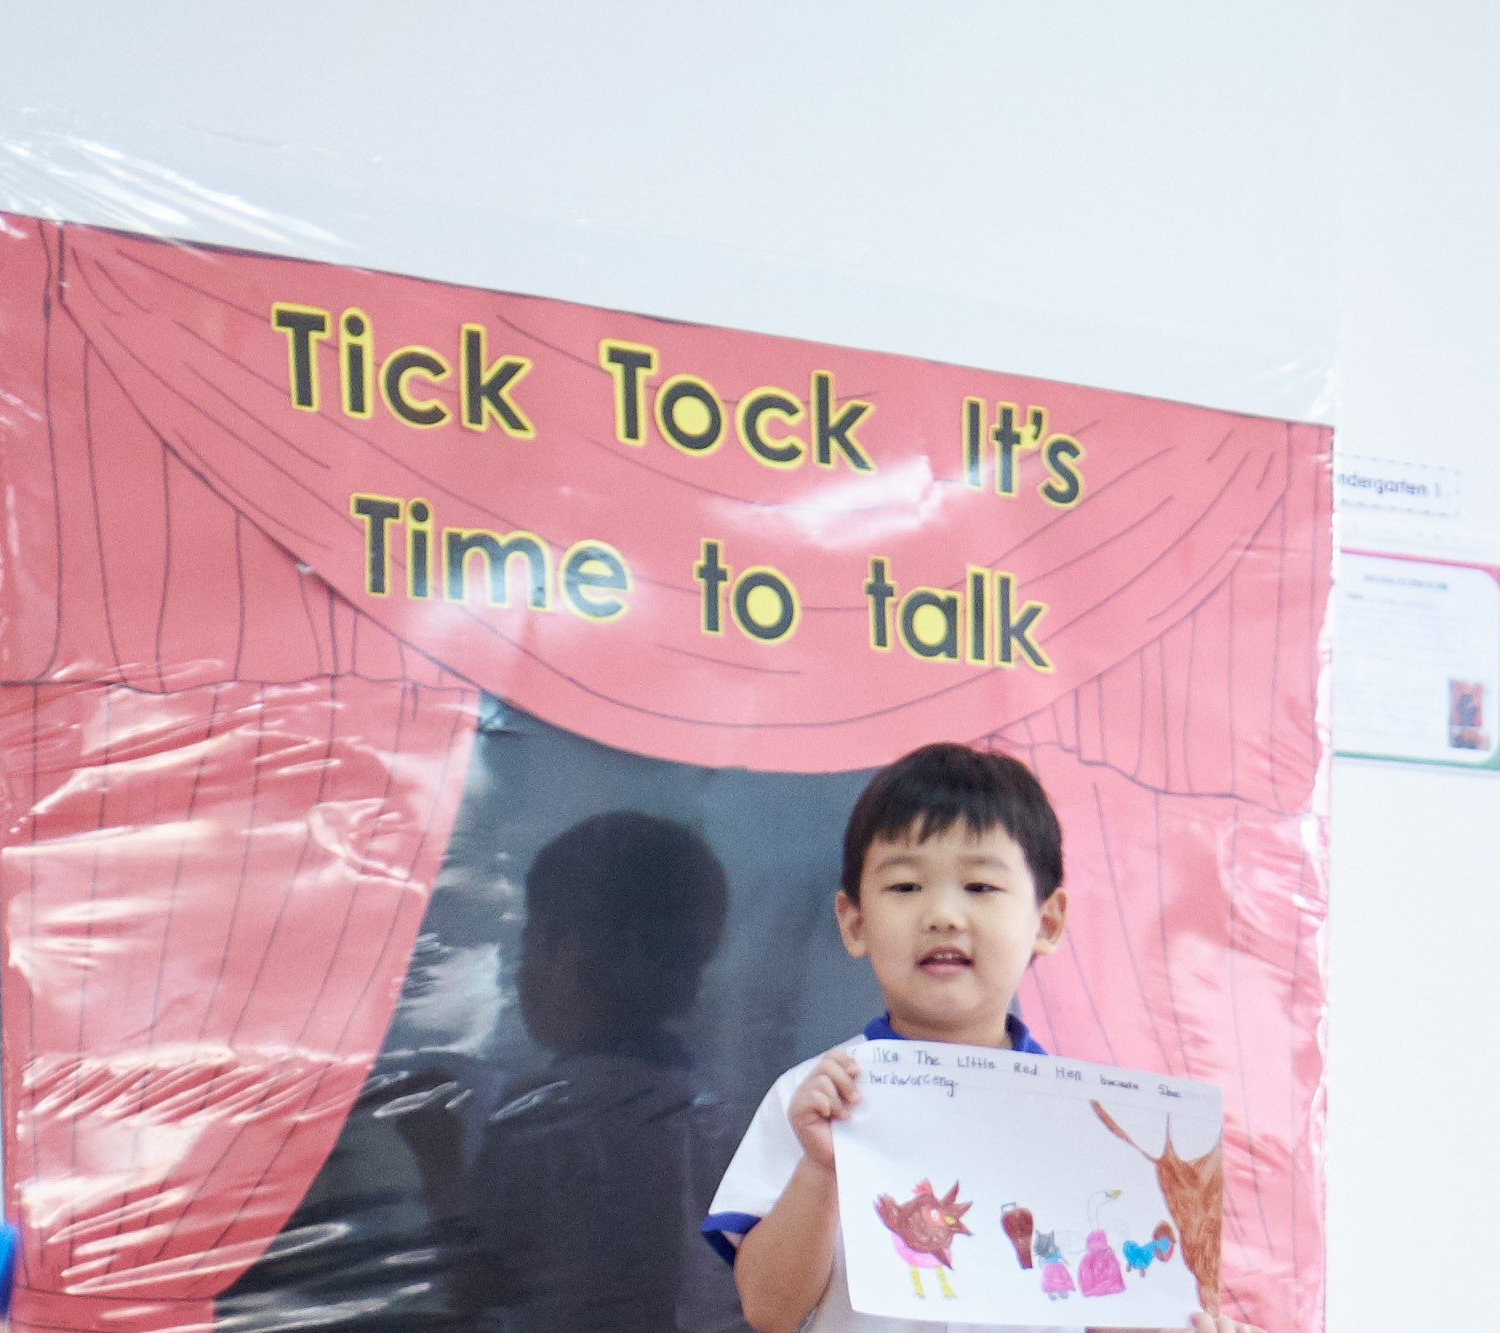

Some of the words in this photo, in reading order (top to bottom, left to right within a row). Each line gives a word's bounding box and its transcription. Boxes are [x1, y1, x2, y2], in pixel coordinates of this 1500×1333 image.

[271, 302, 535, 440] Tick
[599, 339, 876, 473] Tock
[961, 396, 1086, 508] It's
[350, 492, 634, 623] Time
[694, 537, 799, 644] to
[864, 556, 1056, 673] talk
[914, 1049, 941, 1067] The
[1013, 1062, 1038, 1077] Red
[1056, 1066, 1082, 1082] Hen
